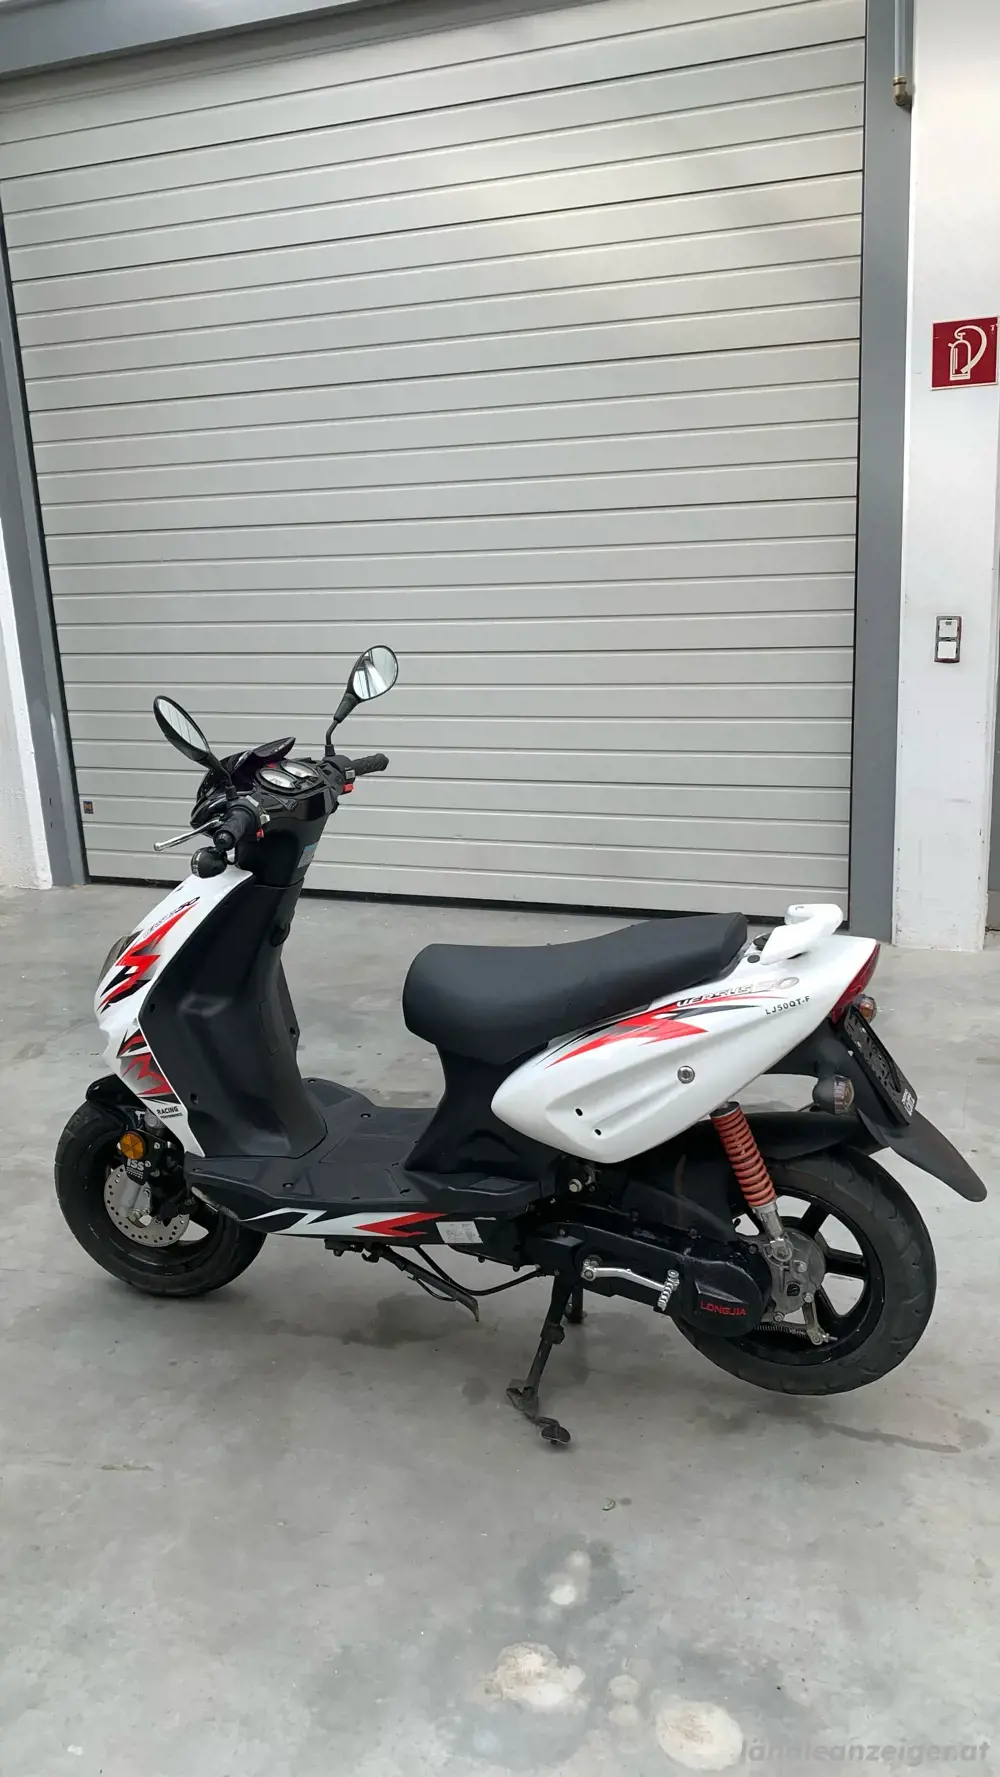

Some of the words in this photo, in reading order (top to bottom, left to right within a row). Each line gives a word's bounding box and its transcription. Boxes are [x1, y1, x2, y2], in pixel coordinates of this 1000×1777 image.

[765, 995, 811, 1015] LJ50QT-F
[157, 1106, 179, 1115] RACING
[700, 1301, 747, 1316] LONGJIA
